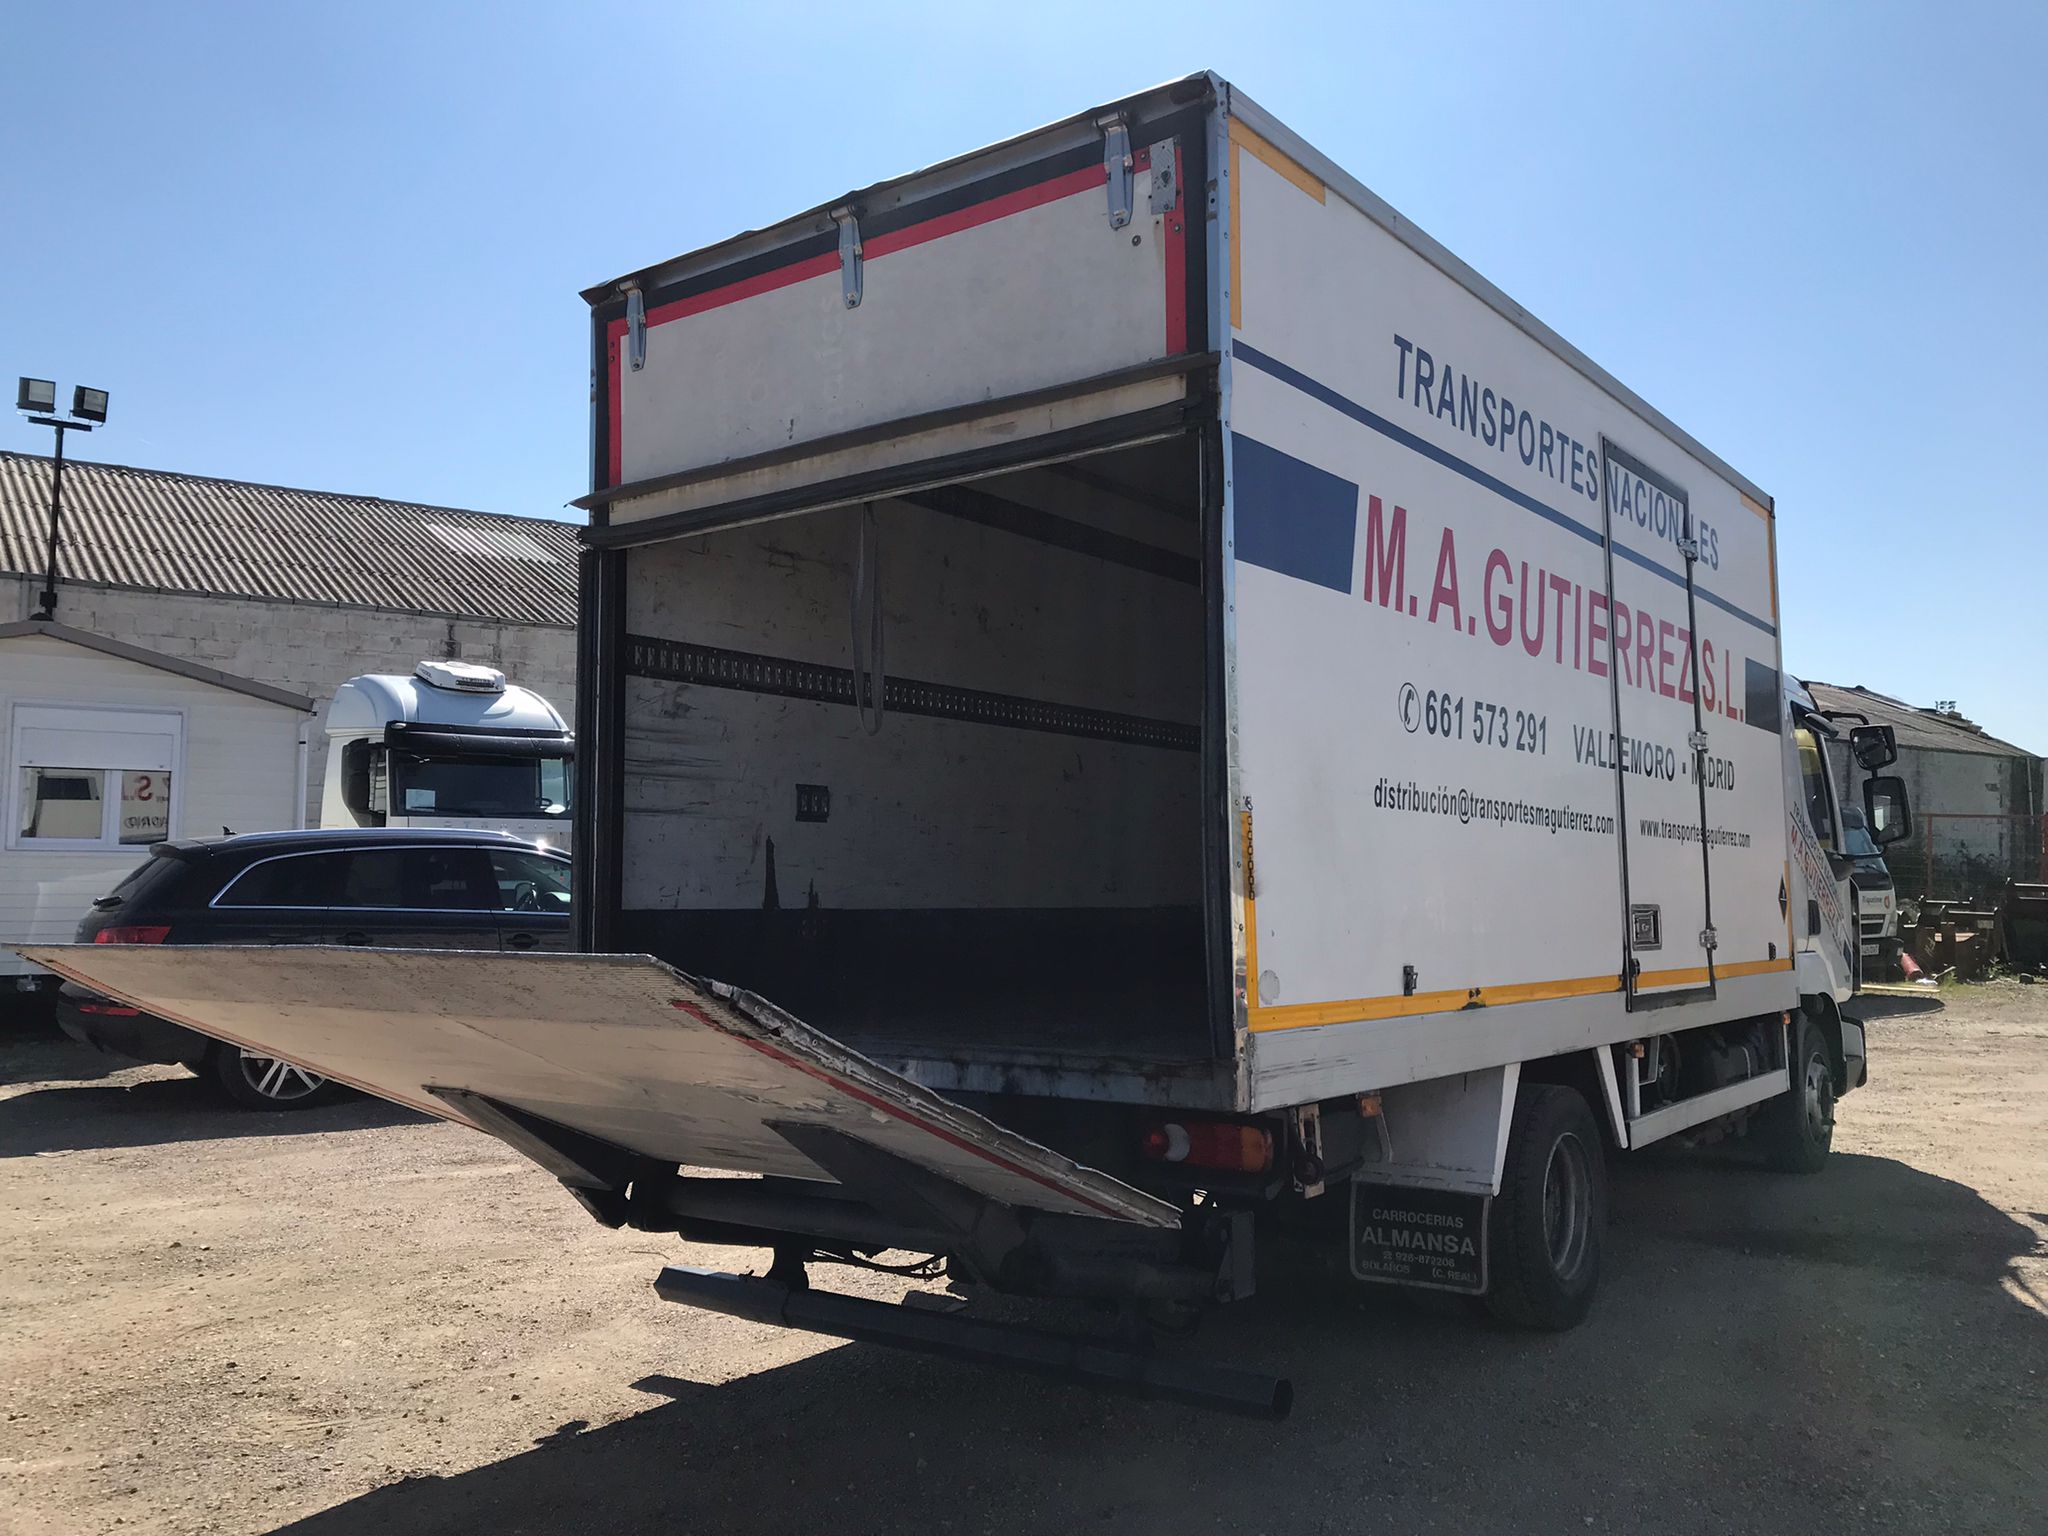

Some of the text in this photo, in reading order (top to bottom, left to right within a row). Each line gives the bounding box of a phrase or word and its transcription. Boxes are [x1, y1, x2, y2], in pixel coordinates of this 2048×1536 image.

[1394, 334, 1719, 571] TRANSPORTES NACIONES
[1426, 690, 1547, 755] 661 573 291
[1573, 724, 1676, 782] VALDEMORO
[1691, 752, 1735, 791] MADRID
[1373, 778, 1615, 834] distribución@transportesmagutierrez.com
[1639, 818, 1751, 850] www.transportesagutierrez.com
[1361, 1226, 1477, 1257] ALMANSA
[1372, 1208, 1464, 1229] CARROCERIAS
